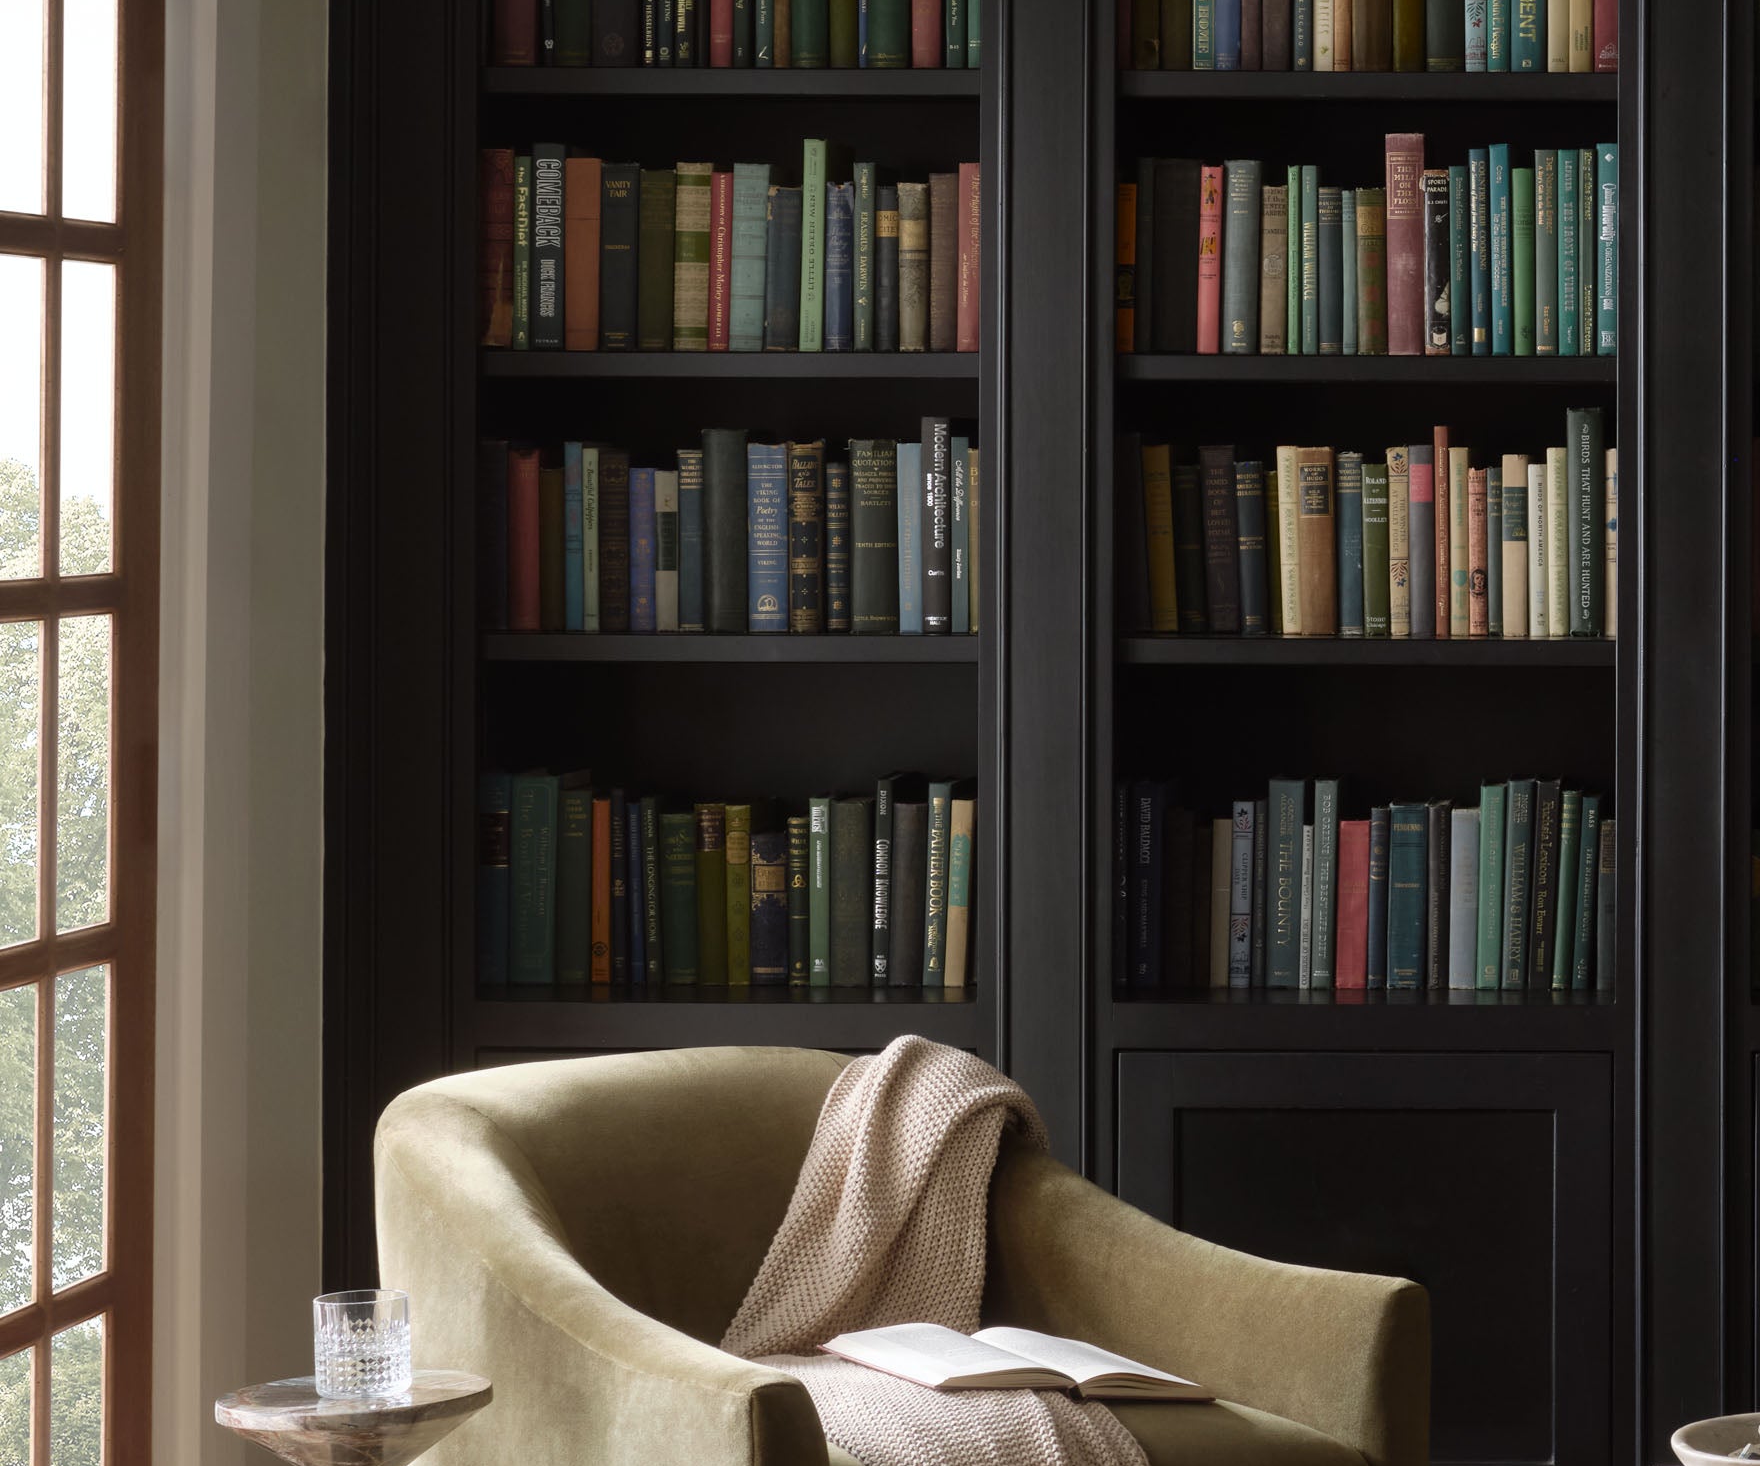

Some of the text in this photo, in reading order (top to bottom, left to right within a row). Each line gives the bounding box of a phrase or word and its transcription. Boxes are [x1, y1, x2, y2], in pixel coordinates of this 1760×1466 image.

[605, 181, 631, 189] VANITY
[609, 189, 628, 198] FAIR
[536, 159, 561, 318] COMEBACK DICK FRANCIS
[1304, 222, 1316, 300] WILLIAM WALLACE
[934, 424, 946, 548] Modern Architecture
[1582, 435, 1591, 608] BIRDS THAT HUNT AND ARE HUNTED
[1140, 798, 1151, 821] DAVID
[1539, 801, 1554, 884] Fuchsia Lexicon
[874, 839, 889, 929] COMMON KNOWLEDGE
[931, 829, 943, 877] FATHER
[1277, 841, 1292, 947] THE BOUNTY
[930, 880, 943, 917] BOOK
[1509, 844, 1524, 962] WILLIAM & HARRY
